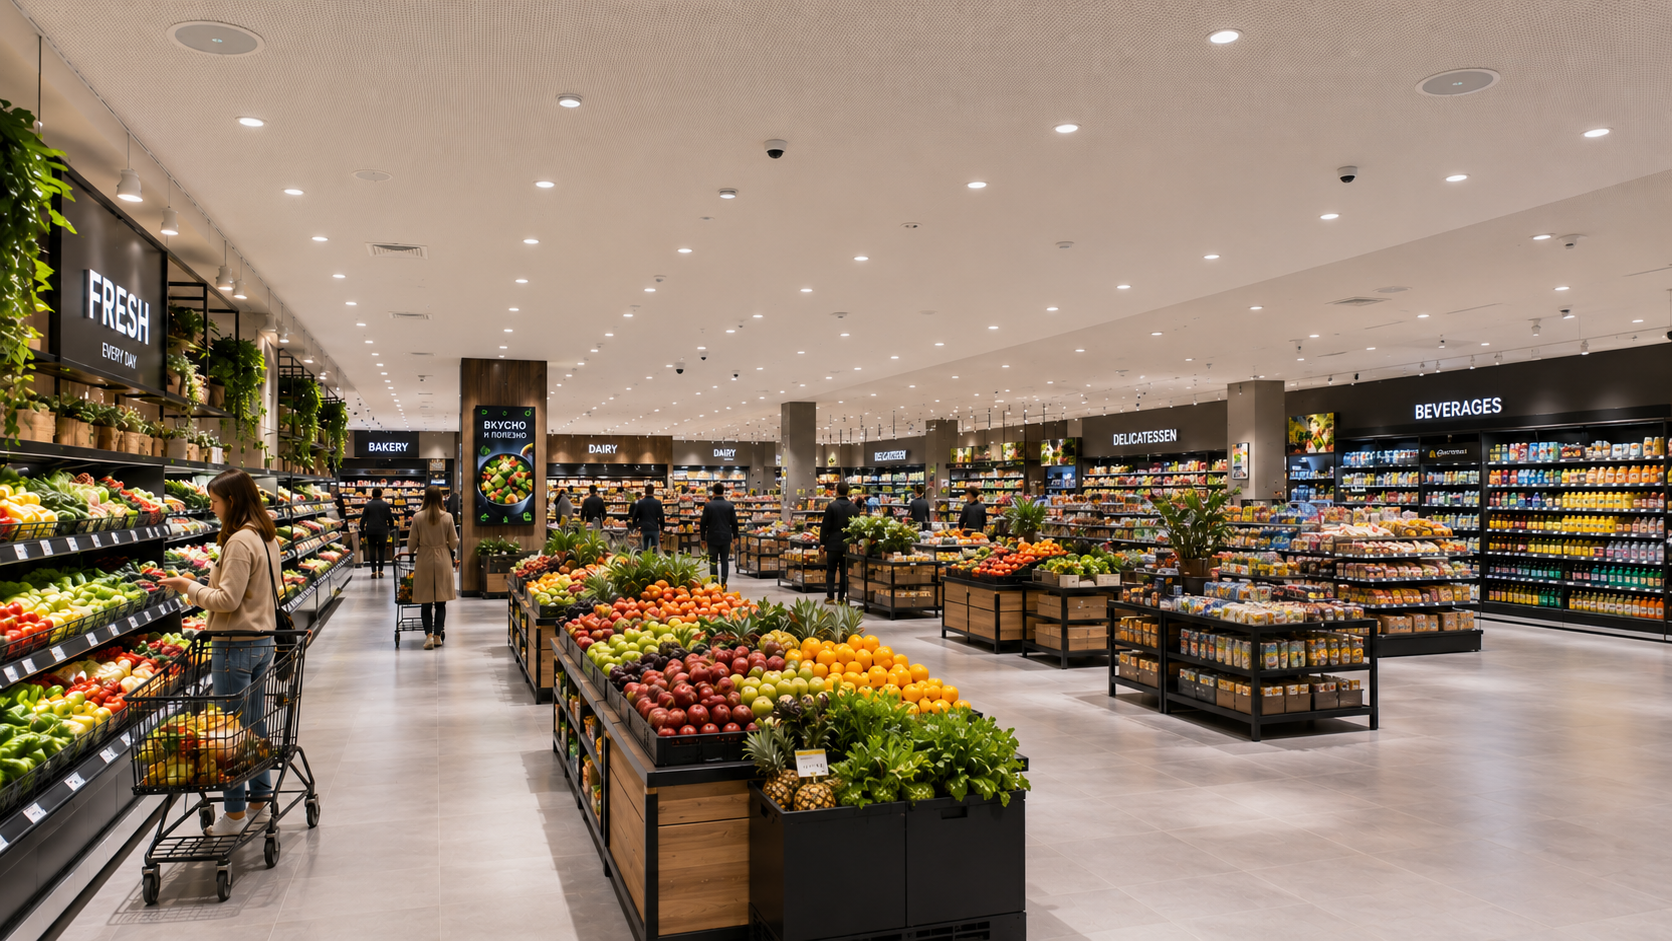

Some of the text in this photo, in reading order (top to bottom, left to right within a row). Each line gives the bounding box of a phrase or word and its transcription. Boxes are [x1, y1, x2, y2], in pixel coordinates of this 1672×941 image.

[89, 268, 150, 345] FRESH
[102, 341, 138, 369] EVERY DAY
[1415, 397, 1502, 420] BEVERAGES
[483, 420, 527, 429] ВКУСНО
[1113, 429, 1177, 446] DELICATESSEN
[368, 442, 409, 452] BAKERY
[588, 444, 618, 454] DAIRY
[713, 448, 736, 457] DAIRY
